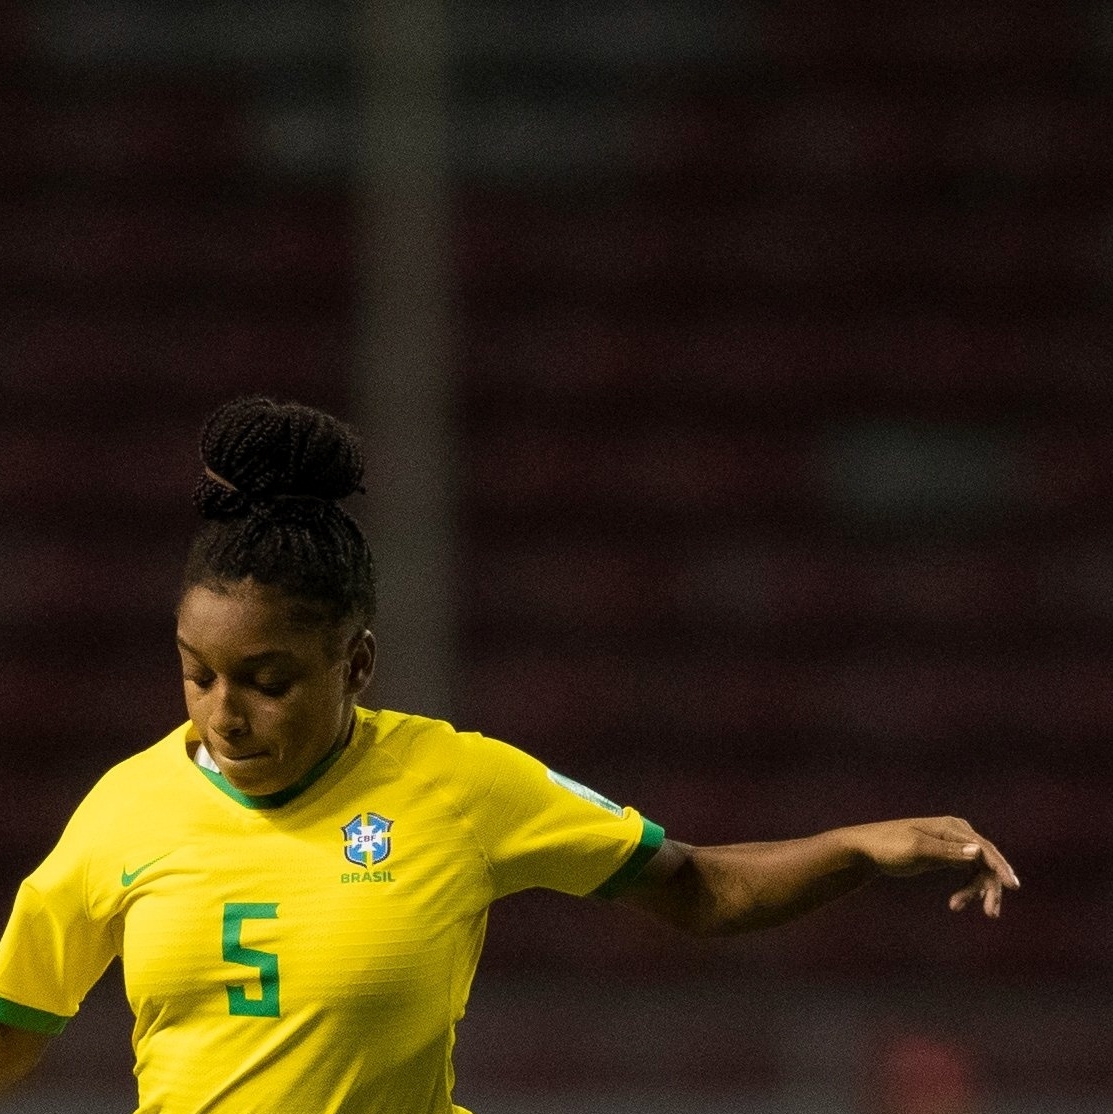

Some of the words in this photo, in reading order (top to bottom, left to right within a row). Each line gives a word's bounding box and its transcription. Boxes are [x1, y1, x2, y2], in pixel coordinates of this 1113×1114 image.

[357, 834, 376, 843] CBF
[340, 870, 396, 884] BRASIL
[222, 902, 280, 1018] 5
